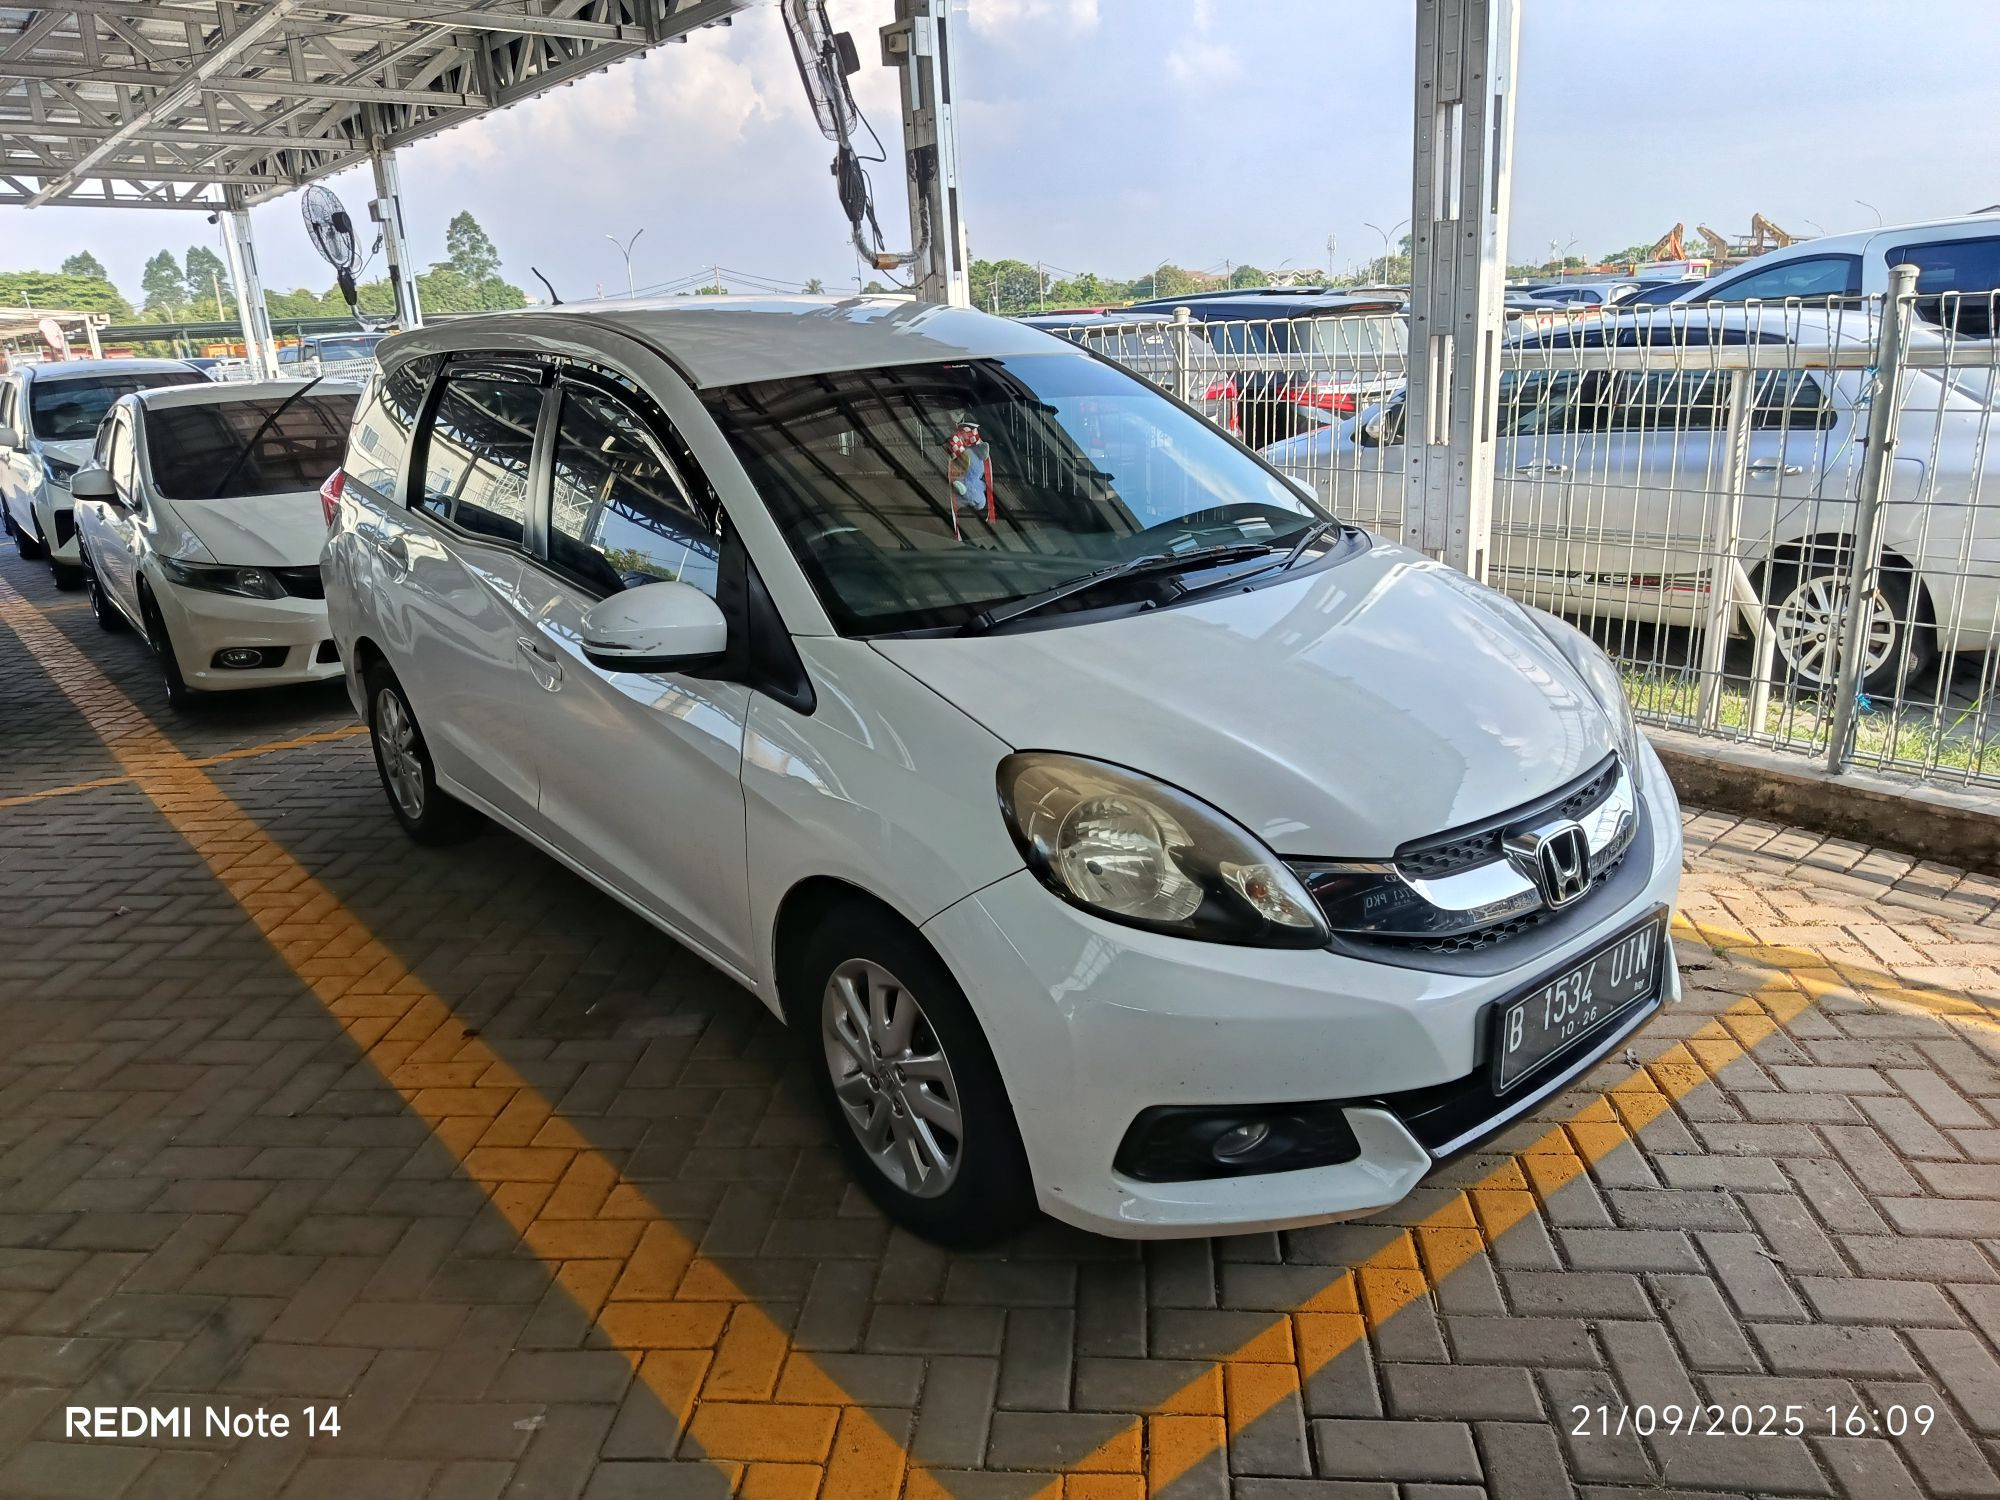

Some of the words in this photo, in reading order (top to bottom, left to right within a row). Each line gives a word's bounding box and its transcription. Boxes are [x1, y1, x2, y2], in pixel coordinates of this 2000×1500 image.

[1509, 1006, 1525, 1053] B
[1544, 962, 1596, 1031] 1534
[1611, 929, 1651, 987] UIN
